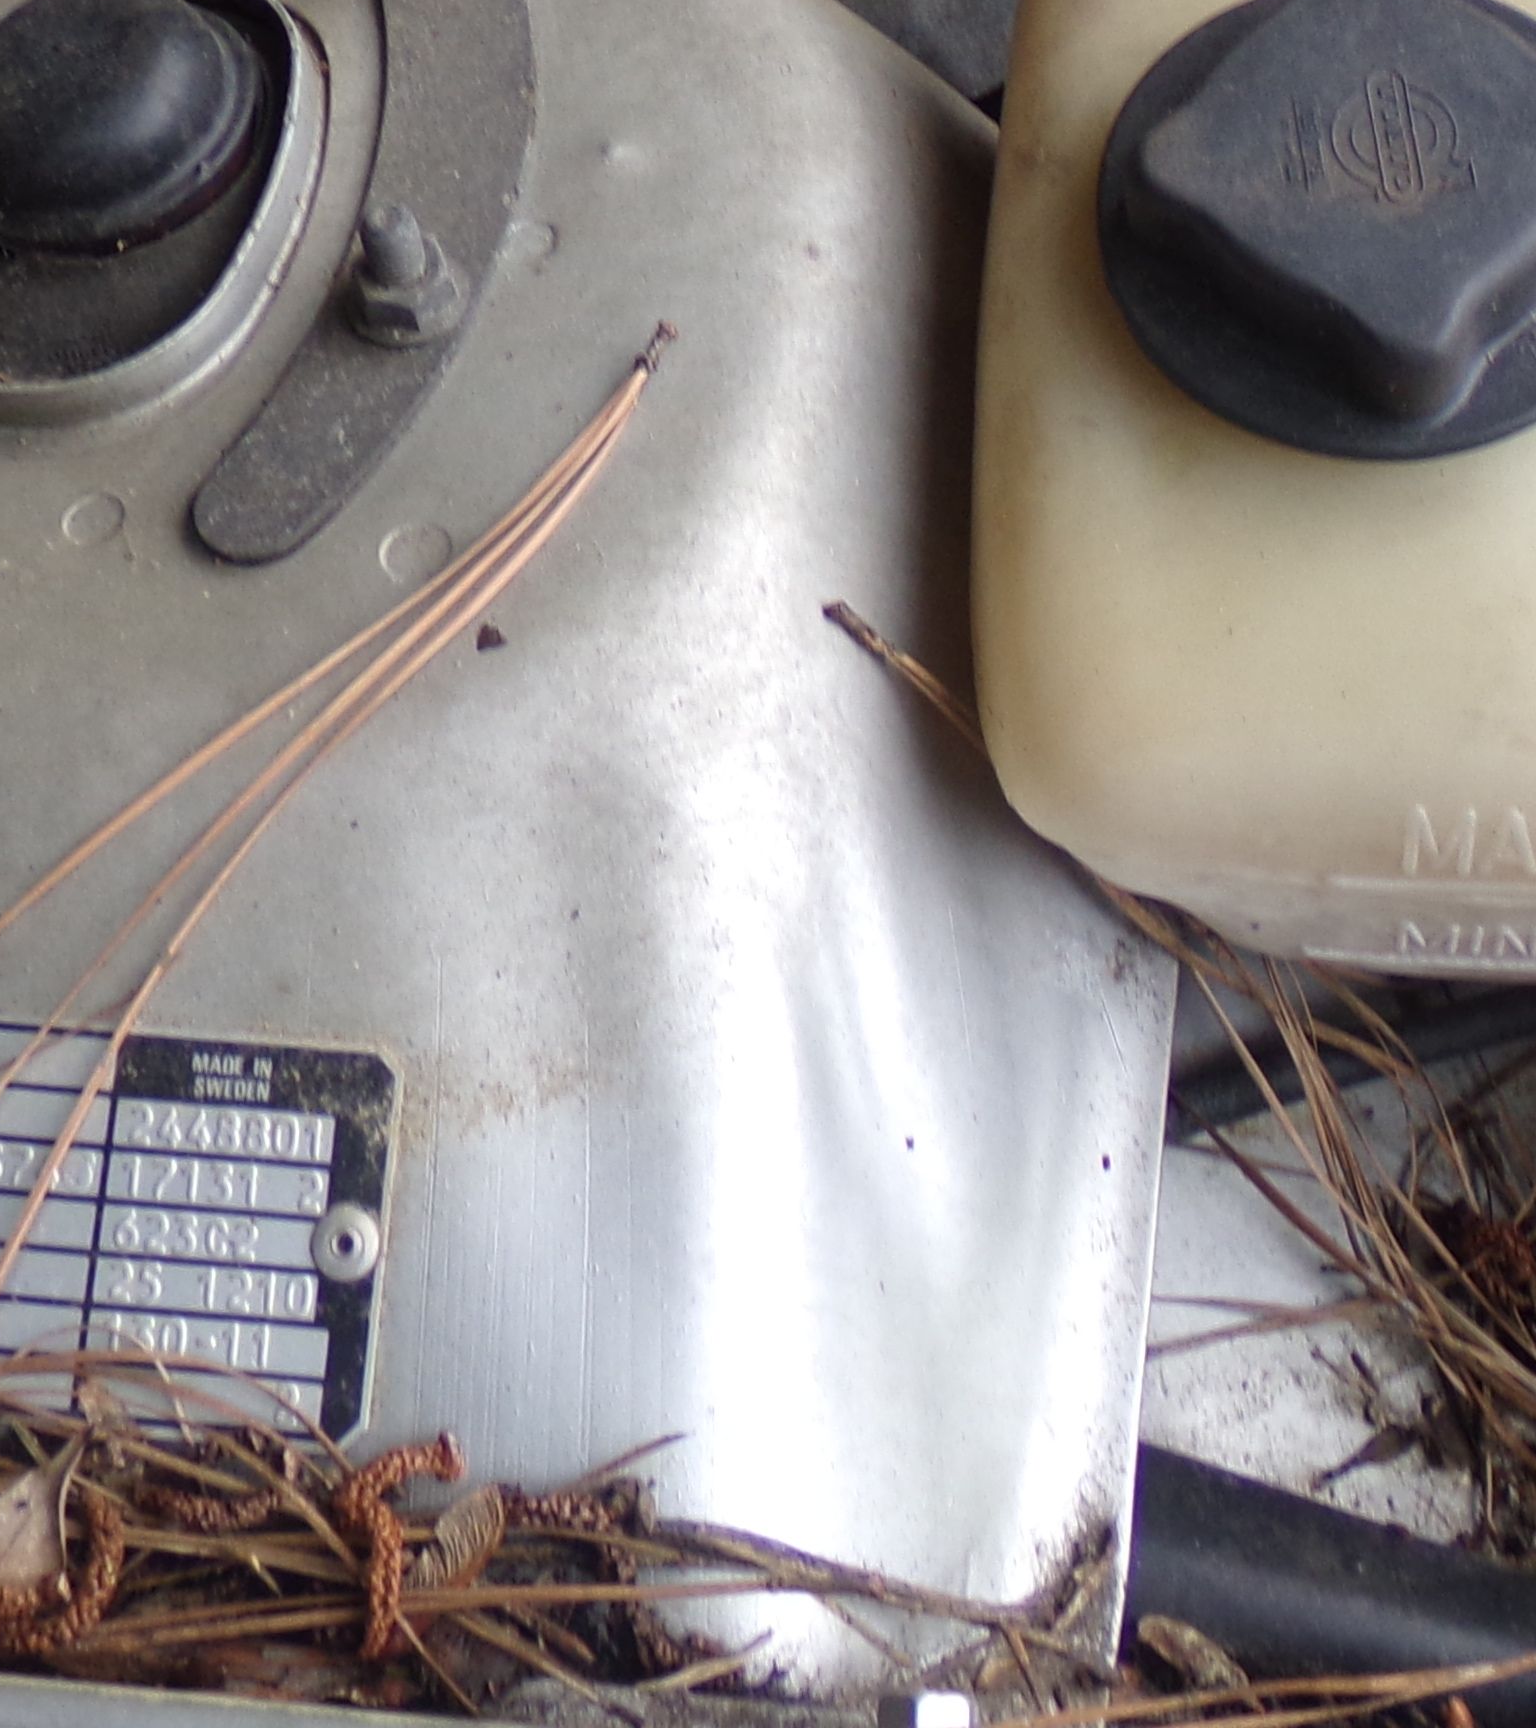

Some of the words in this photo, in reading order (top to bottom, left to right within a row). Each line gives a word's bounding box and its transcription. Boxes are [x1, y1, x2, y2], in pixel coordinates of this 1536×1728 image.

[190, 1050, 244, 1077] MADE
[252, 1055, 273, 1080] IN
[193, 1073, 272, 1103] SWEDEN
[128, 1103, 323, 1162] 2448801
[122, 1154, 260, 1208] 17131
[197, 1266, 315, 1317] 1210
